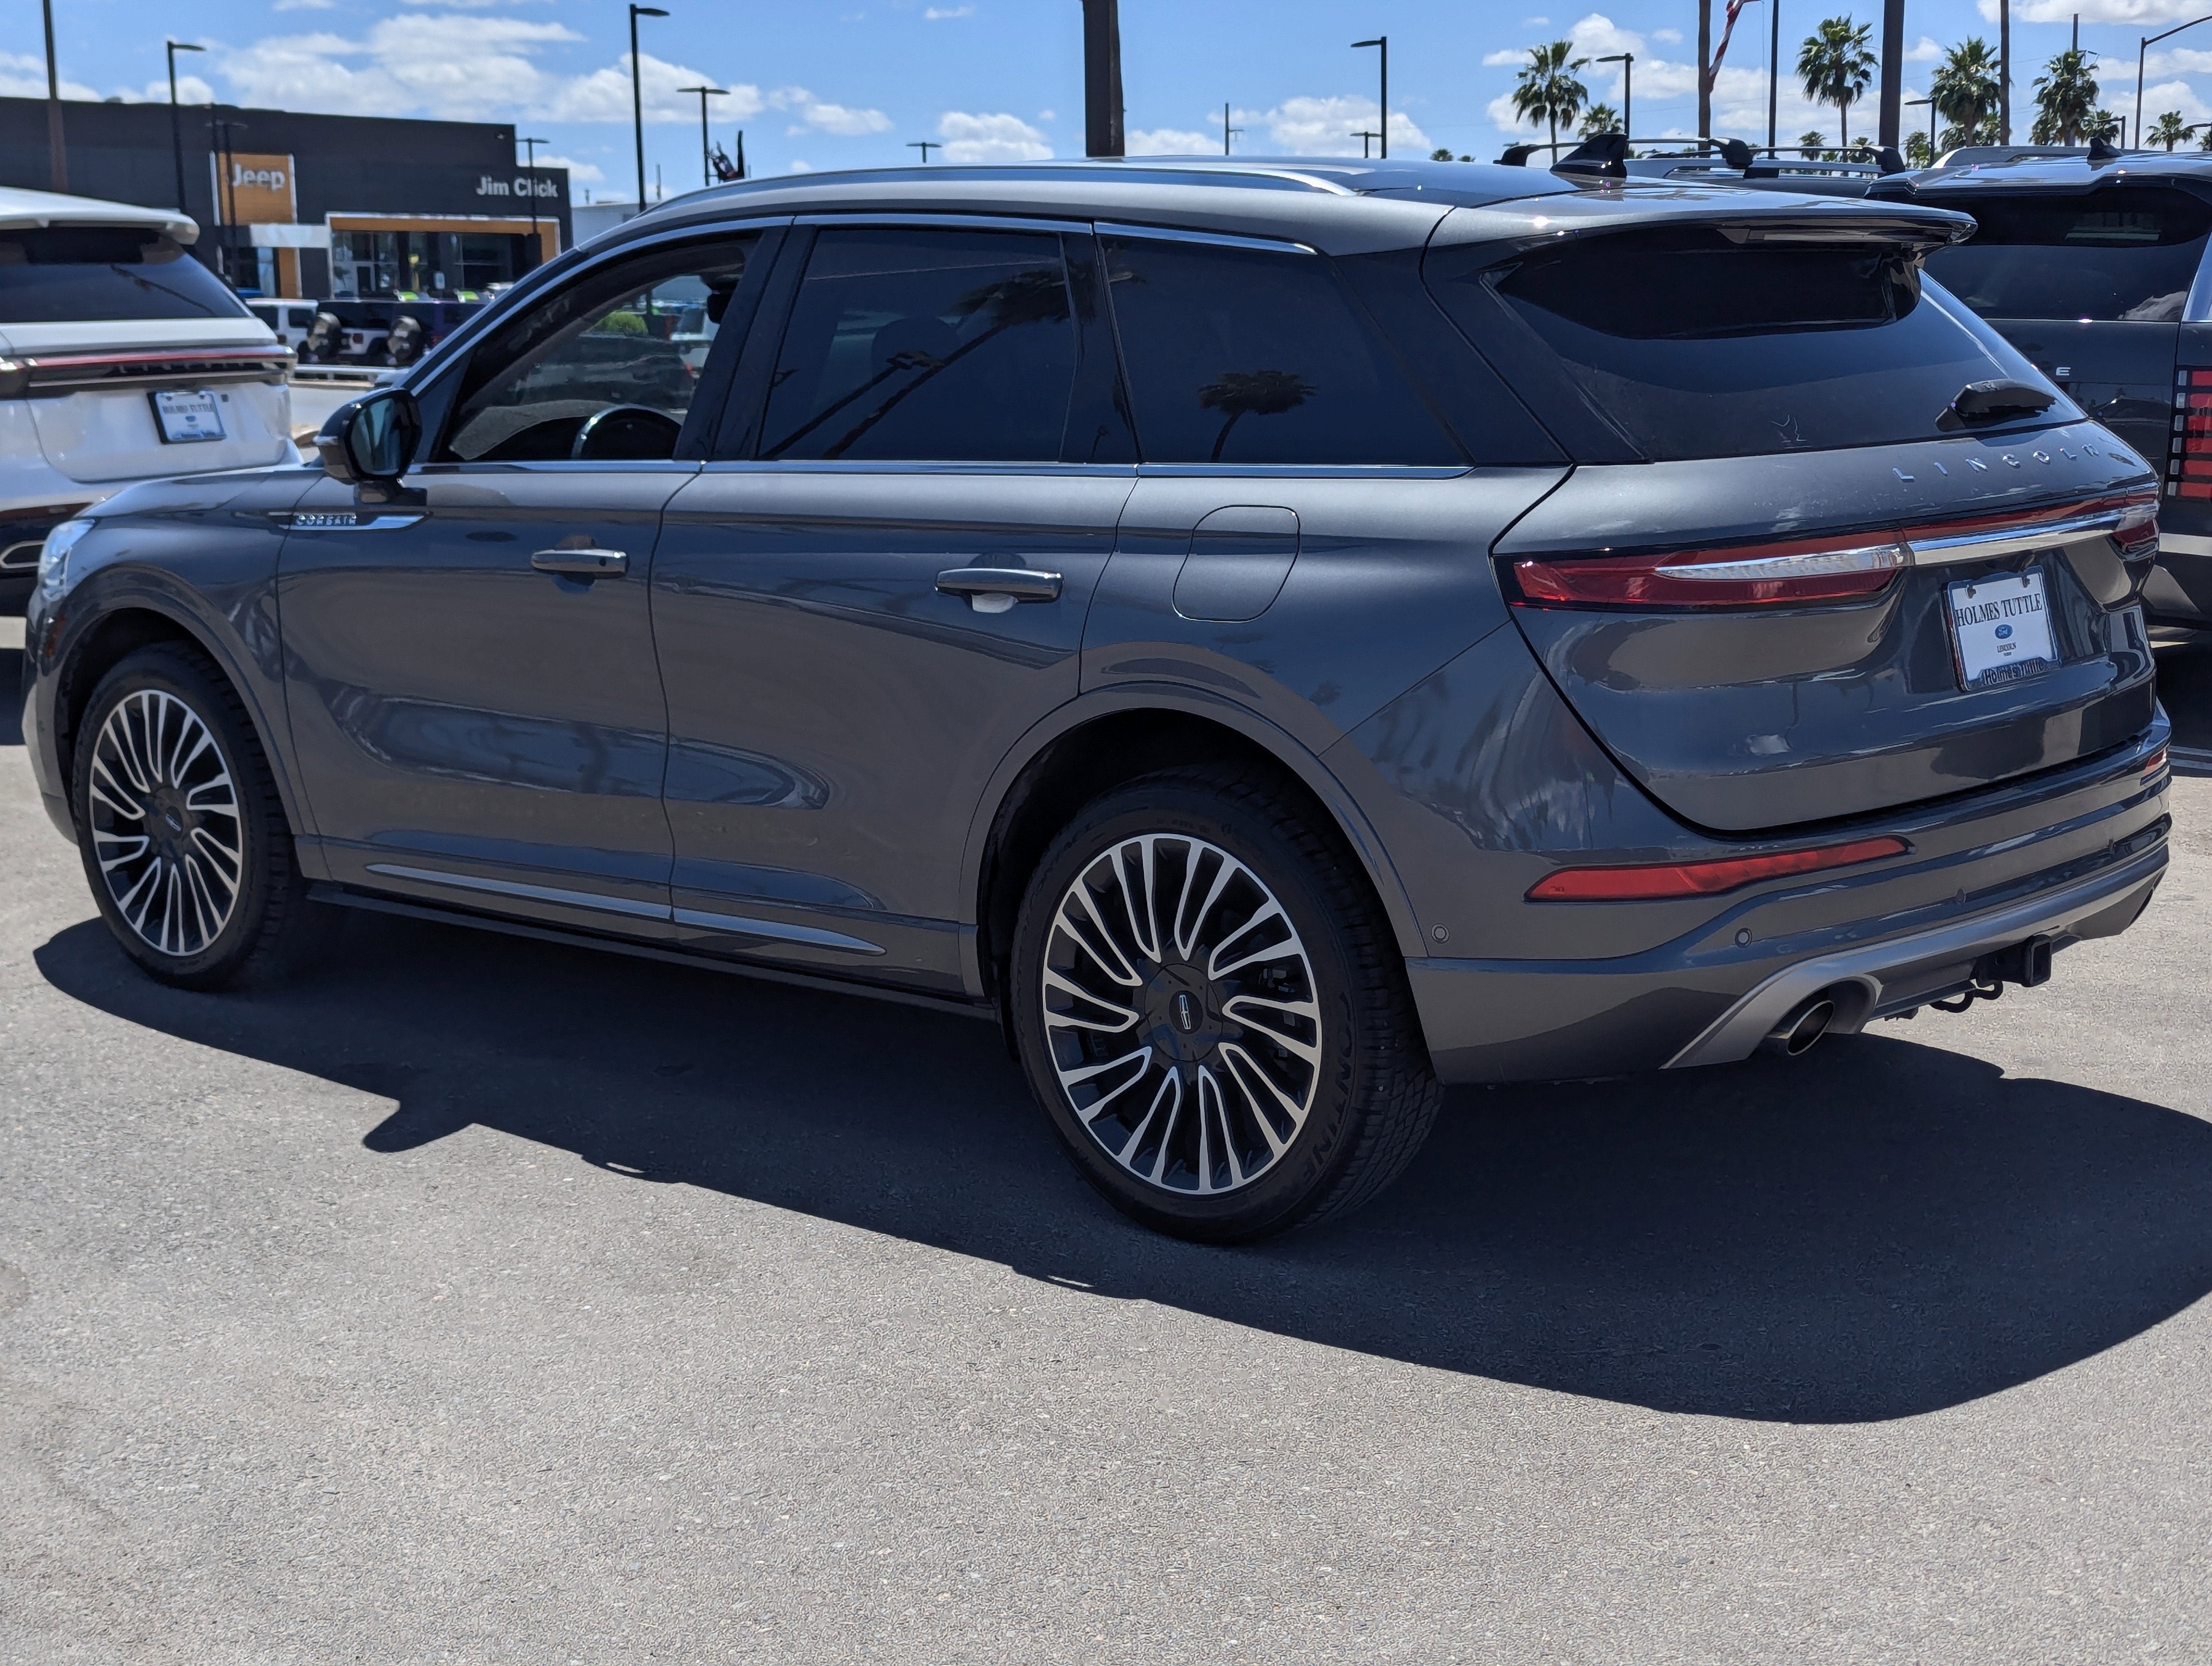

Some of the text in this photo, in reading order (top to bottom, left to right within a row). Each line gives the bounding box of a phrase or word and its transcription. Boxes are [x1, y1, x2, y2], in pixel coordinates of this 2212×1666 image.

[233, 162, 285, 191] Jeep
[475, 174, 558, 197] Jim Click
[1892, 443, 2099, 482] LINCOLN
[1955, 593, 2043, 627] HOLMES TUTTLE
